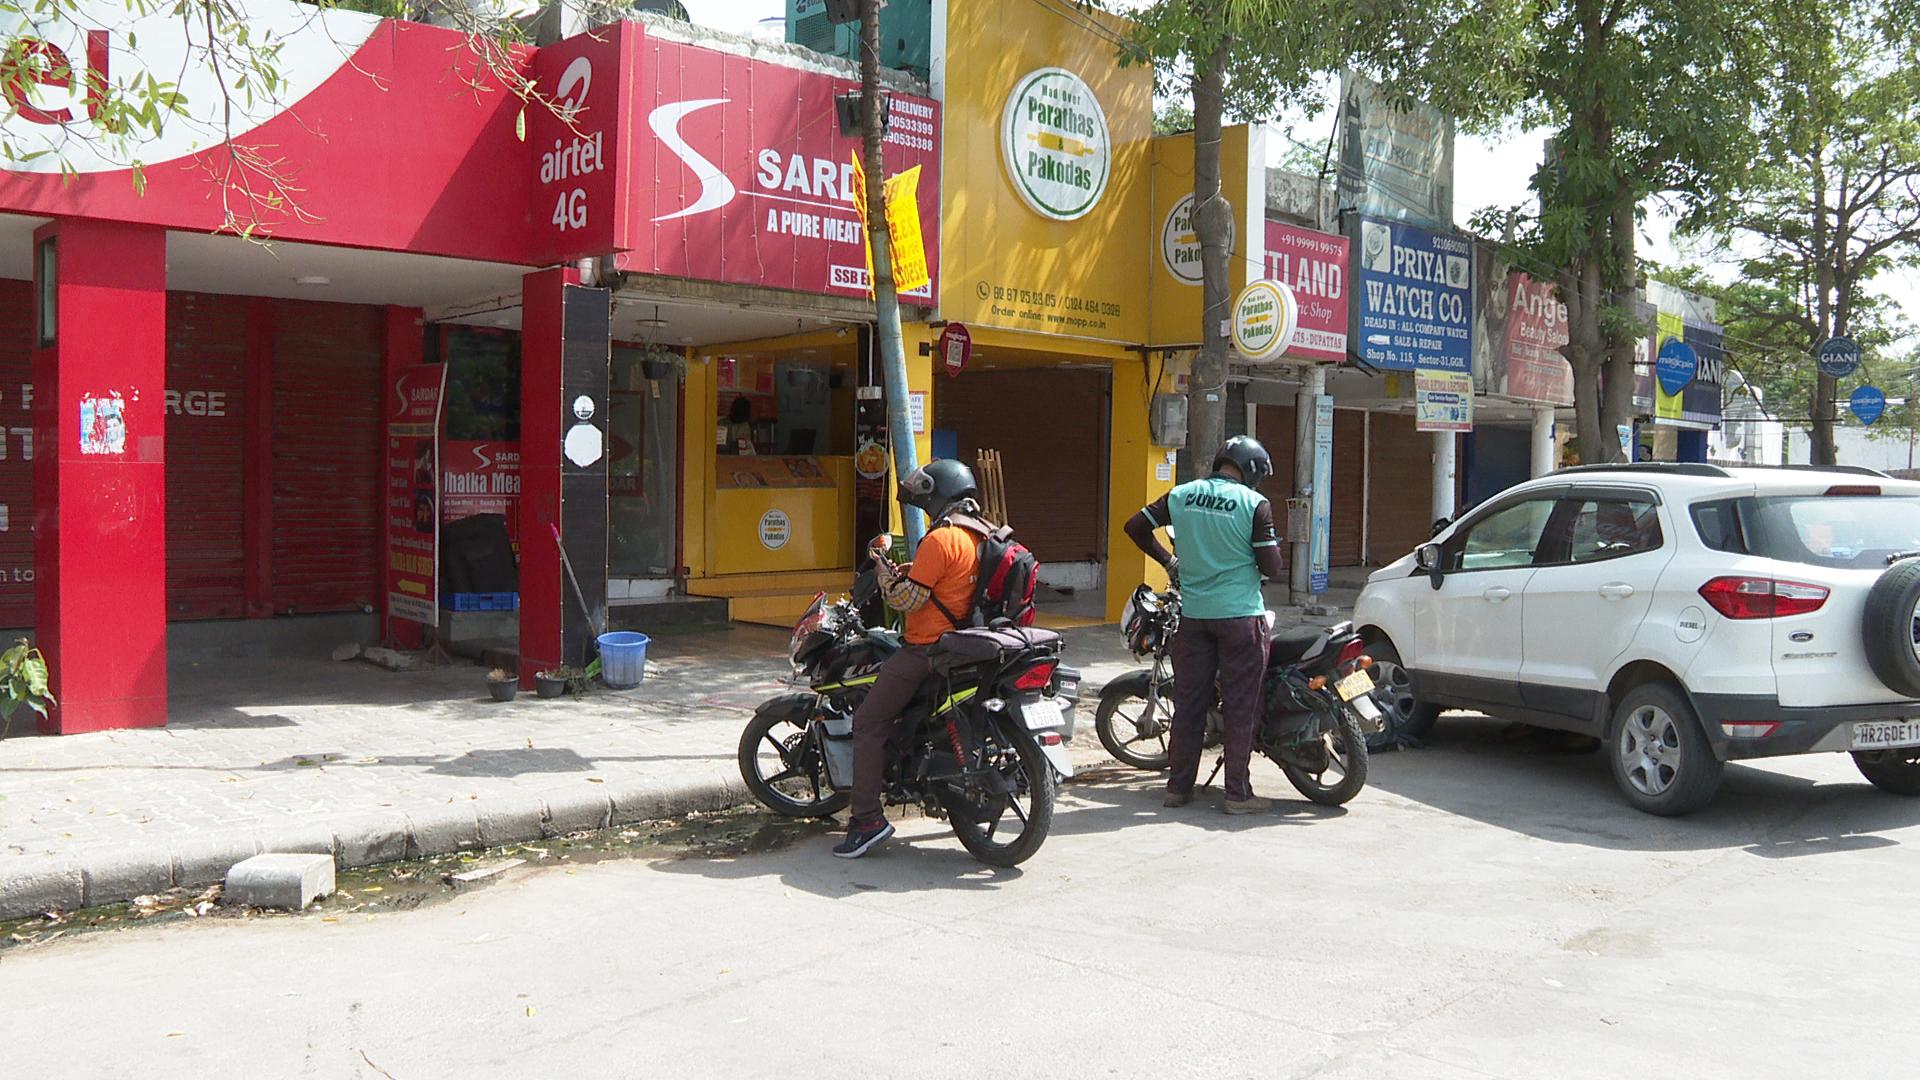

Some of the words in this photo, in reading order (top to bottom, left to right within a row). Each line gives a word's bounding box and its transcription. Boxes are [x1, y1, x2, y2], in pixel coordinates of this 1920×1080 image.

[1042, 84, 1058, 99] Mad
[1062, 90, 1080, 106] Over
[896, 100, 933, 119] DELIVERY
[1028, 96, 1094, 138] Parathas
[540, 130, 604, 184] airtel
[1028, 151, 1091, 191] Pakodas
[552, 188, 587, 232] 4G
[767, 208, 778, 233] A
[785, 212, 819, 238] PURE
[823, 220, 861, 244] MEAT
[1265, 249, 1343, 300] TLAND
[1393, 245, 1446, 285] PRIYA
[834, 268, 858, 285] SSB
[991, 304, 1015, 318] Order
[1242, 300, 1273, 317] Parathas
[1310, 302, 1333, 324] Shop
[1366, 279, 1434, 321] WATCH
[1438, 292, 1468, 325] CO.
[1512, 283, 1568, 327] Ange
[1243, 323, 1273, 340] Pakodas
[1364, 316, 1388, 330] DEALS
[1388, 319, 1396, 330] IN
[1401, 321, 1414, 333] ALL
[1415, 324, 1445, 337] COMPANY
[1446, 326, 1468, 340] WATCH
[1520, 321, 1545, 345] Beauty
[1309, 332, 1343, 349] DUPATTAS
[1394, 335, 1412, 347] SALE
[1419, 338, 1443, 351] REPAIR
[1366, 348, 1385, 362] Shop
[1386, 350, 1398, 361] No.
[1399, 351, 1415, 365] 115,
[1658, 355, 1694, 369] magicpin
[1821, 352, 1857, 363] GIANI
[1697, 356, 1722, 385] IANI
[1185, 493, 1238, 512] DUNZO
[1680, 621, 1698, 630] DIESEL
